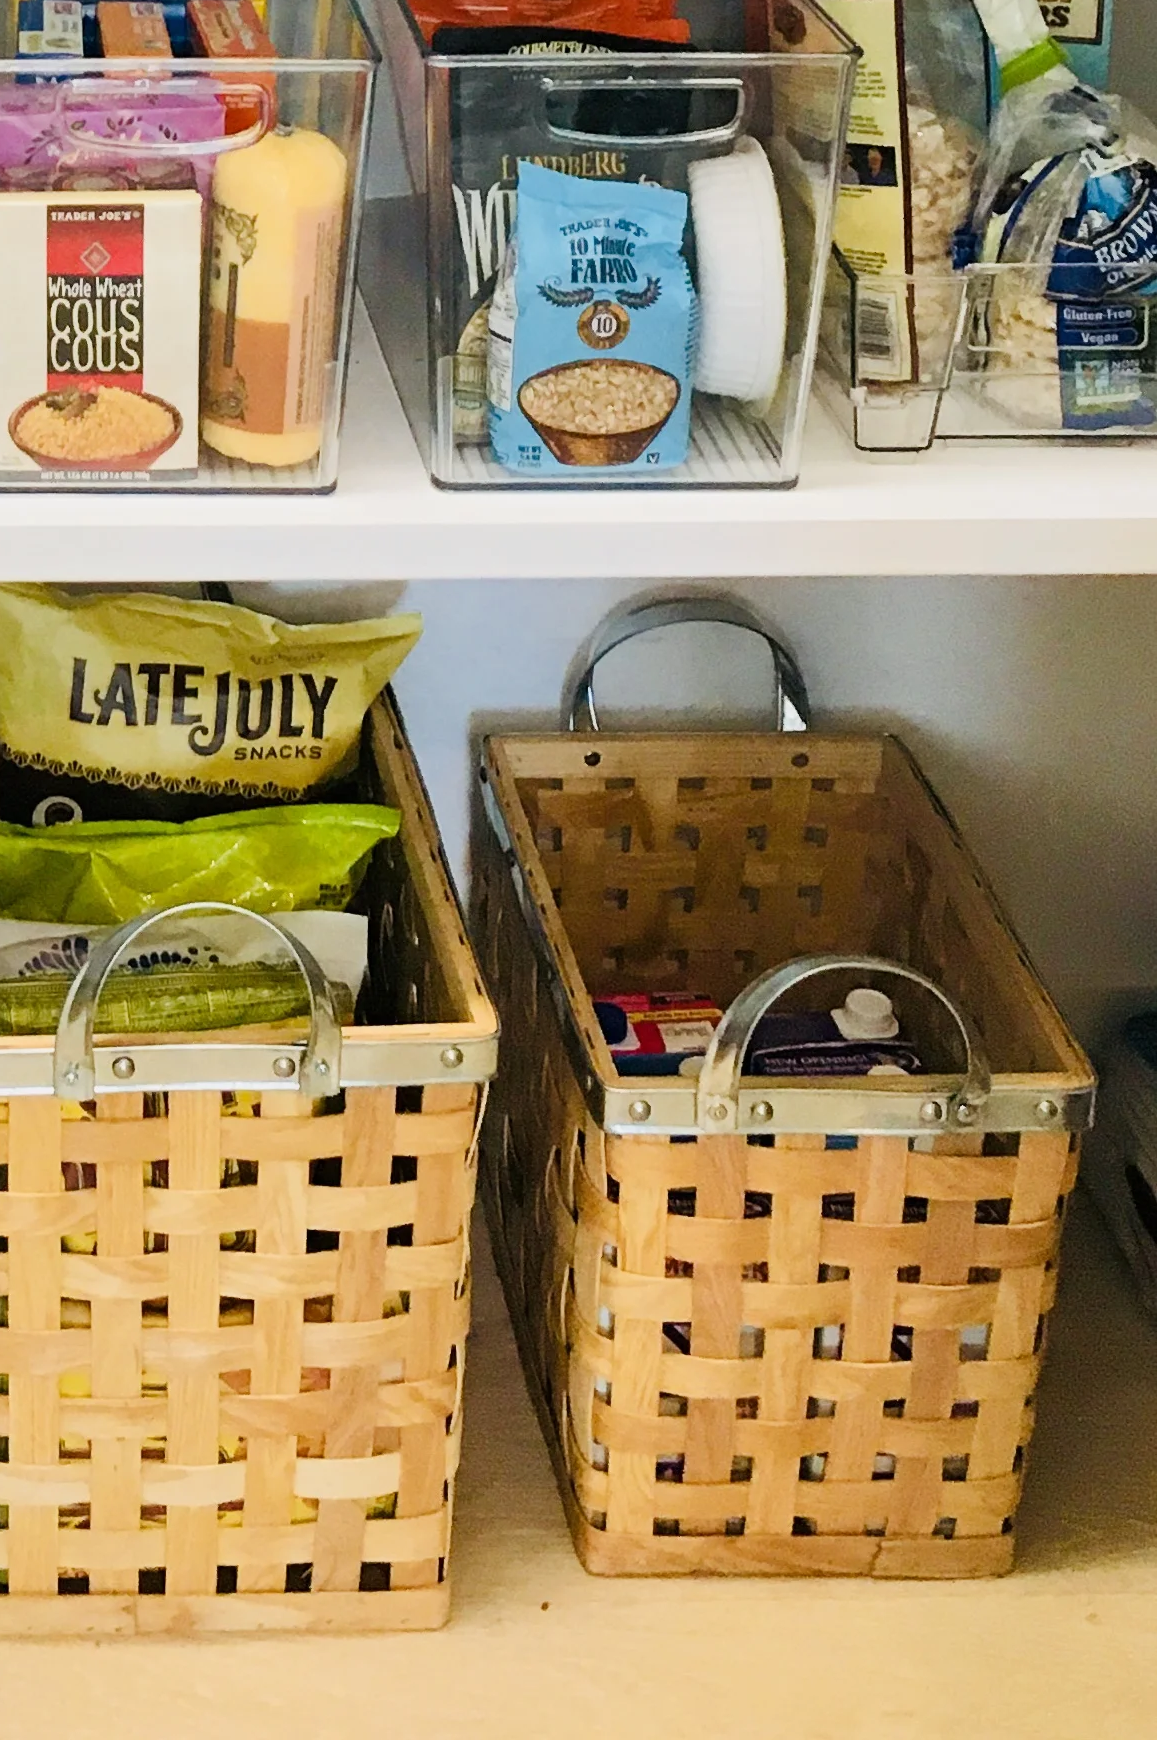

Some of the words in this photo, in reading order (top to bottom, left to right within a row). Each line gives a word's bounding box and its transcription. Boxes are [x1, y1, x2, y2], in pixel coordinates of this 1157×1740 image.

[502, 151, 627, 180] LNDBERG
[51, 211, 96, 222] TRADER
[99, 211, 132, 222] JOE'S
[560, 218, 612, 237] TRADER
[569, 237, 589, 255] 10
[570, 258, 638, 284] FARRO
[48, 276, 92, 298] Whole
[95, 276, 143, 298] Wheat
[50, 298, 141, 337] COUS
[1063, 307, 1133, 322] Gluten-Free
[595, 316, 613, 334] 10
[1080, 331, 1119, 346] Vegan
[50, 332, 141, 372] COUS
[69, 657, 205, 726] LATE
[188, 671, 339, 757] JULY
[234, 744, 323, 761] SNACKS
